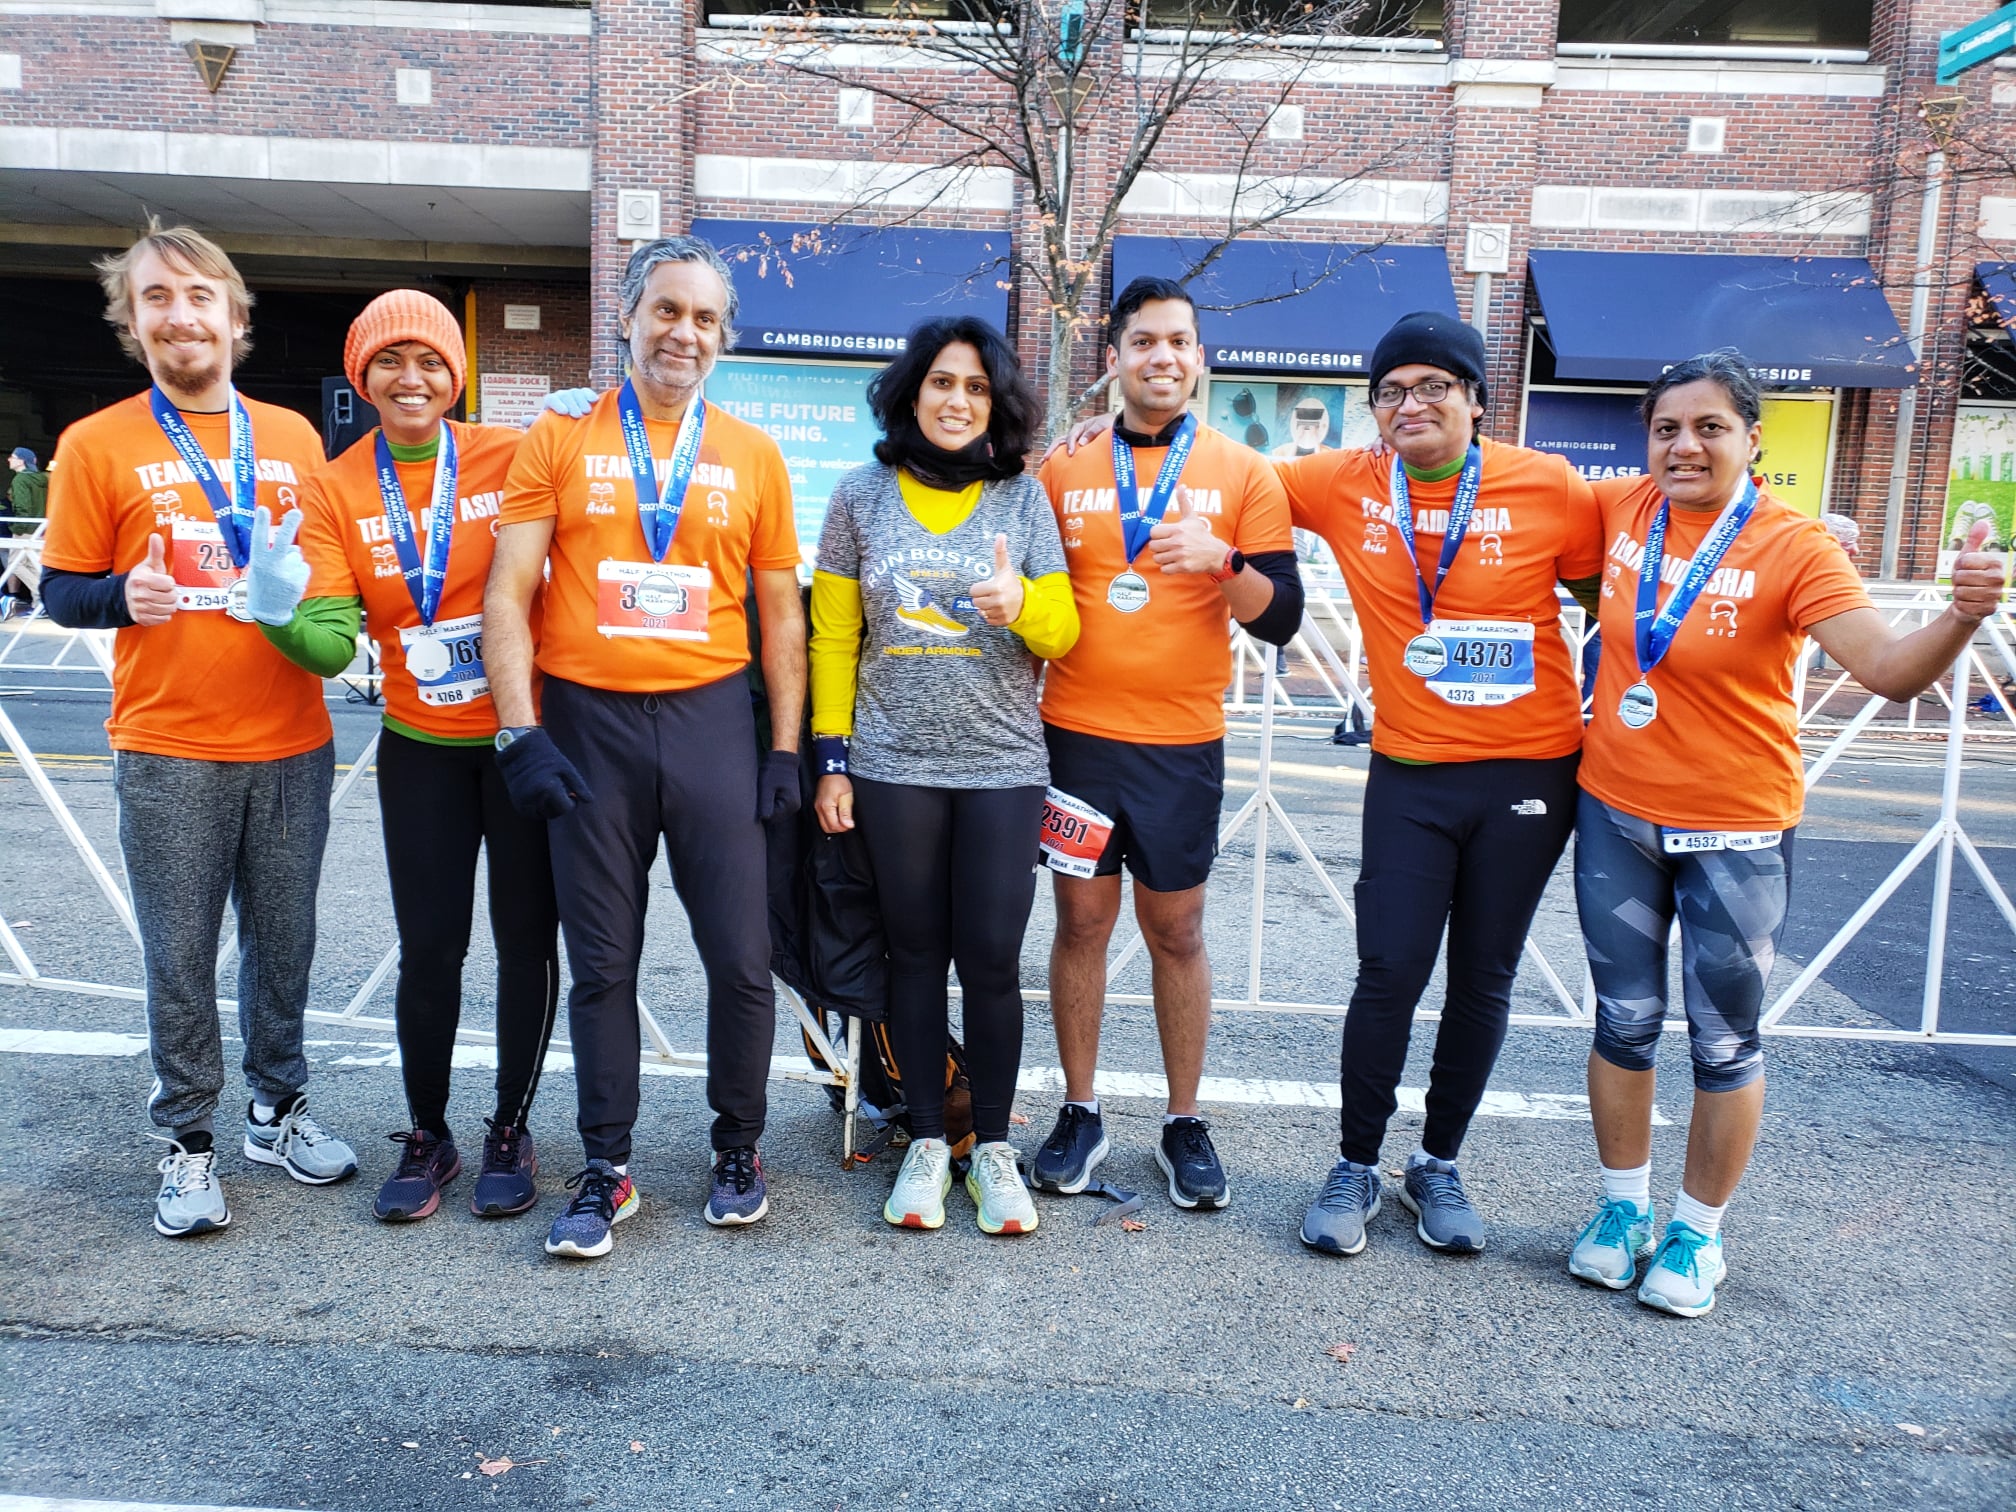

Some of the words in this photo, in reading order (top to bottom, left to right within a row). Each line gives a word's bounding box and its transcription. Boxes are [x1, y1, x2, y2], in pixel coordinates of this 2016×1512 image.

[762, 332, 907, 349] CAMBRIDGESIDE
[1216, 350, 1363, 366] CAMBRIDGESIDE
[483, 376, 517, 384] LOADING
[520, 377, 540, 385] DOCK
[722, 400, 764, 418] THE
[770, 402, 856, 422] FUTURE
[759, 424, 828, 443] ISING.
[625, 409, 637, 429] HALF
[631, 431, 648, 475] MARATHON
[1534, 440, 1617, 450] CAMBRIDGESIDE
[1158, 453, 1180, 494] MARATHON
[1467, 466, 1476, 489] HALF
[585, 501, 616, 516] Asha
[1063, 488, 1115, 514] TEAM
[1121, 510, 1140, 520] 2021
[1415, 509, 1450, 532] AID
[1450, 490, 1471, 540] MARATHON
[1687, 564, 1706, 590] HALF
[1702, 515, 1739, 565] MARATHON
[867, 551, 905, 589] RUN
[910, 548, 993, 580] BOSTO
[195, 594, 229, 607] 2548
[443, 621, 482, 632] MARATHO
[642, 617, 666, 629] 2021
[1476, 626, 1519, 634] MARATHON
[883, 645, 924, 655] UNDER
[1453, 641, 1513, 668] 4373
[453, 669, 477, 682] 2021
[1471, 672, 1496, 683] 2021
[437, 689, 463, 703] 4768
[1446, 689, 1475, 702] 4373
[1061, 799, 1099, 817] MARATHON
[1041, 805, 1089, 844] 2591
[1686, 836, 1718, 849] 4532
